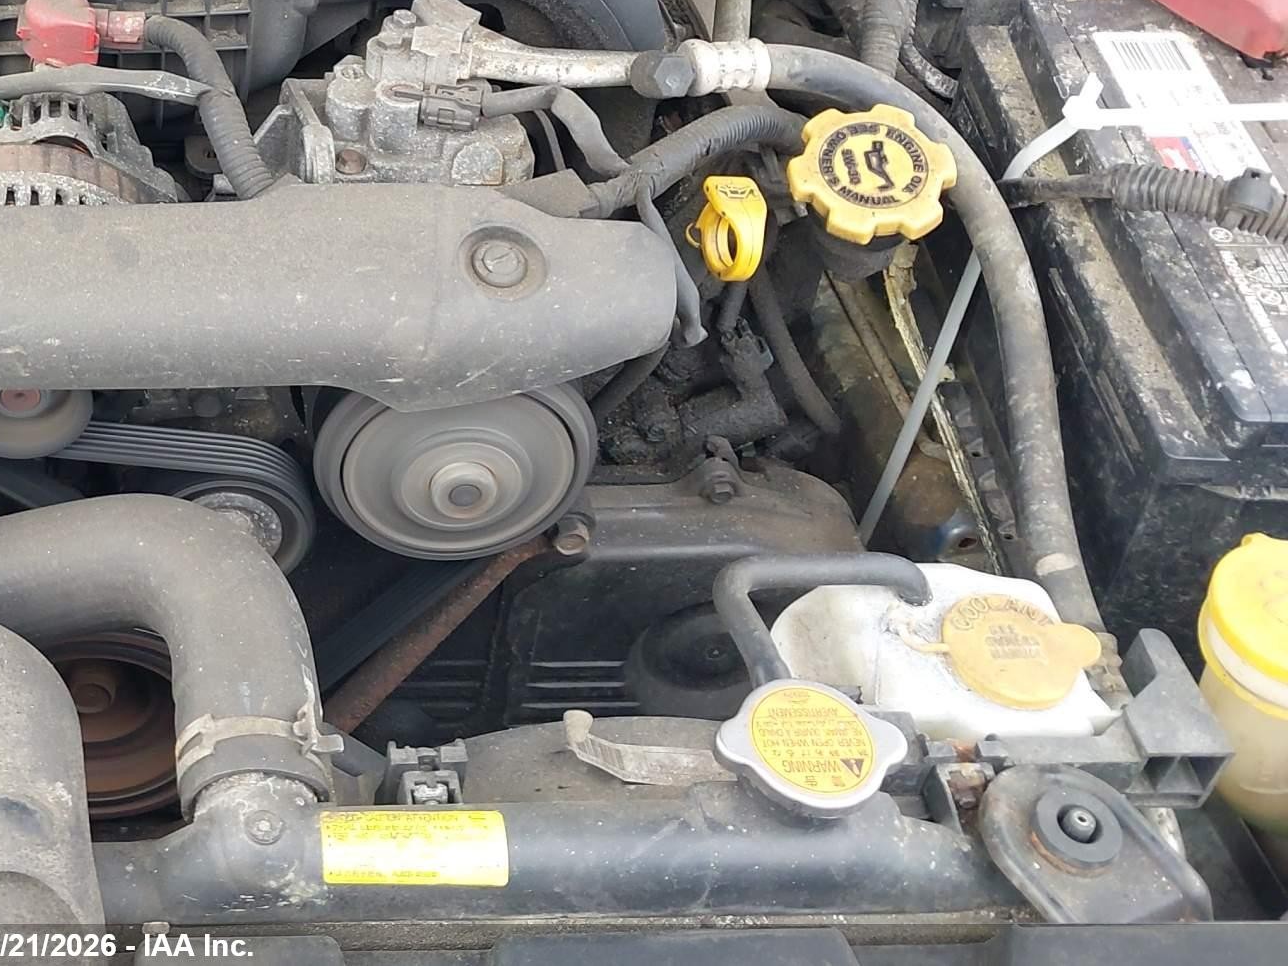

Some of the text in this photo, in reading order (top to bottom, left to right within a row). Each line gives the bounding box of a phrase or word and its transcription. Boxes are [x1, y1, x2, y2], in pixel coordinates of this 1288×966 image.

[841, 149, 861, 185] 5W-30
[885, 126, 924, 193] ENGINE OIL
[838, 185, 900, 206] MANUAL
[952, 596, 1054, 631] COOLANT
[781, 759, 841, 773] WARNING
